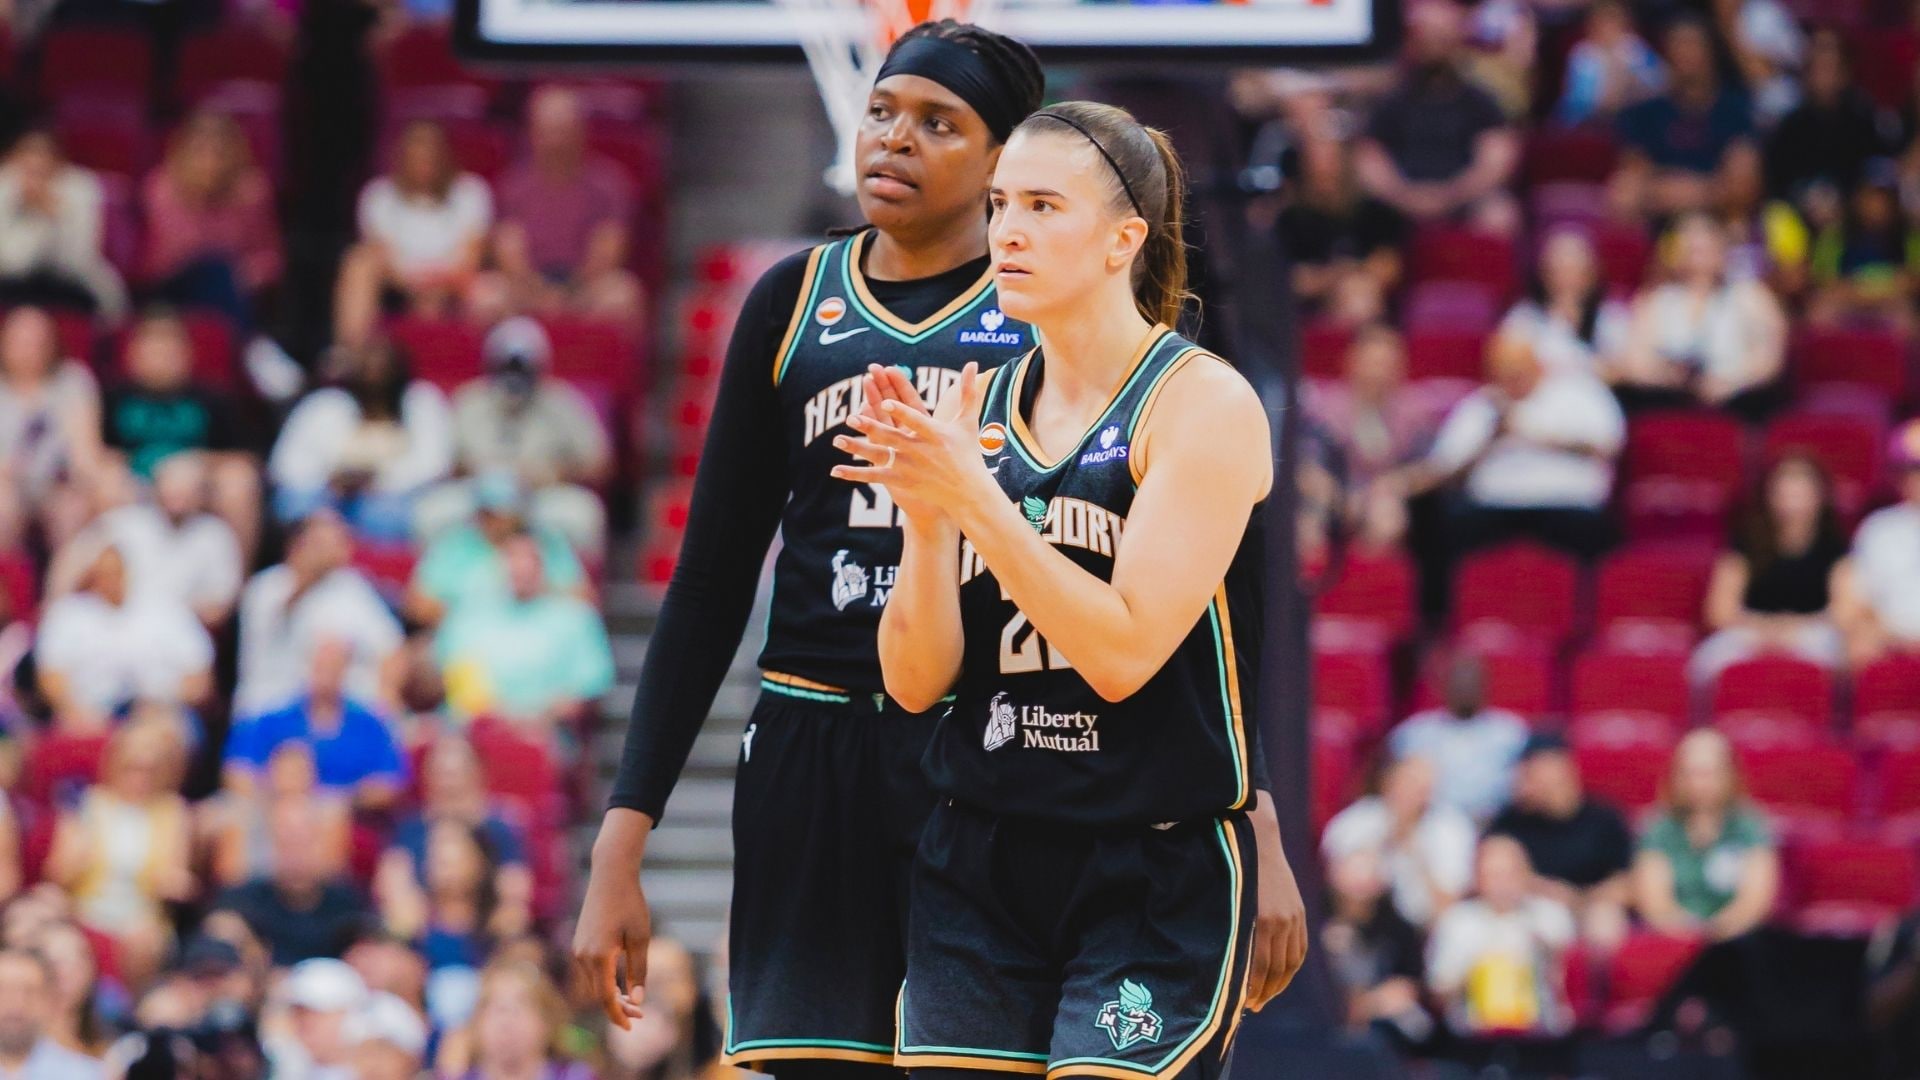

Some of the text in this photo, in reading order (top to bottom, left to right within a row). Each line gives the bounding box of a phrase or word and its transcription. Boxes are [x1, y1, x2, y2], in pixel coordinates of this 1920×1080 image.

[960, 331, 1020, 345] BARCLAYS
[1080, 446, 1127, 465] BARCLAYS
[999, 583, 1072, 674] 2
[1021, 705, 1098, 737] Liberty
[1023, 728, 1100, 752] Mutual
